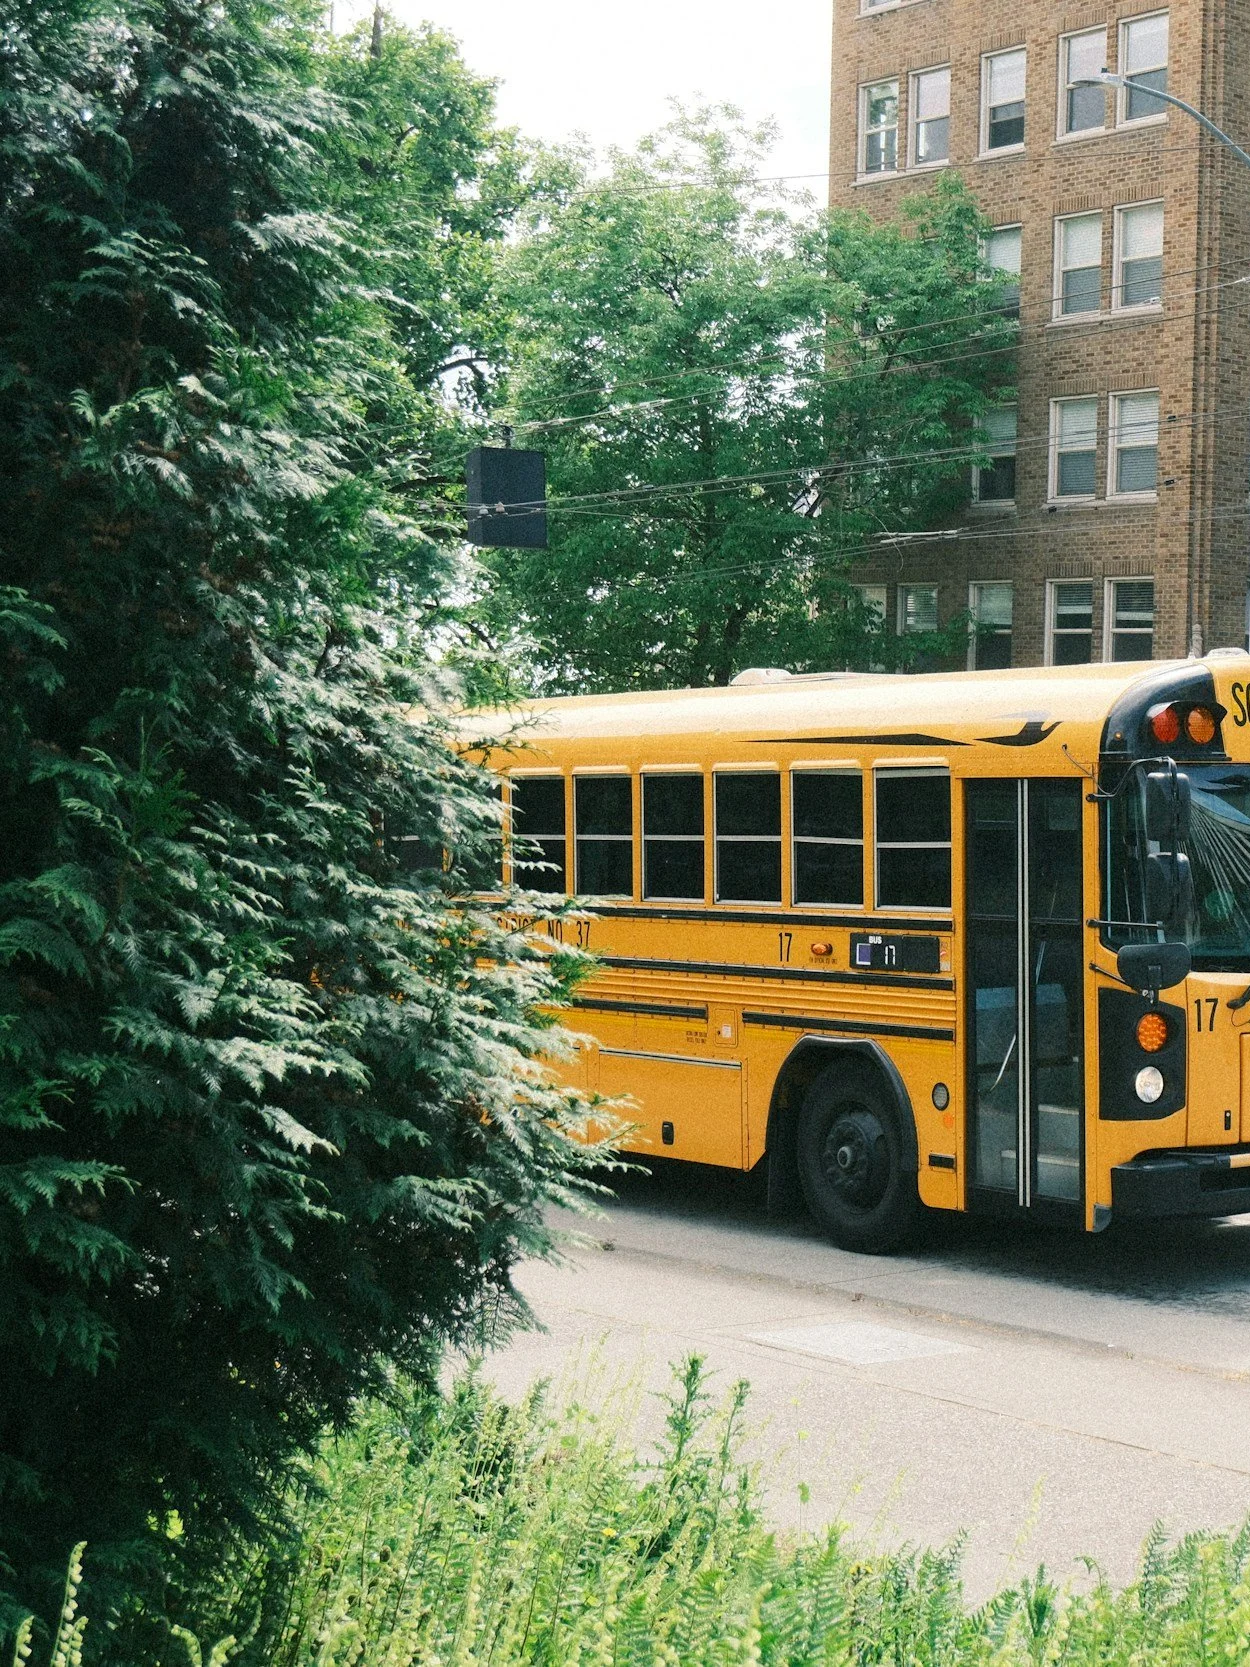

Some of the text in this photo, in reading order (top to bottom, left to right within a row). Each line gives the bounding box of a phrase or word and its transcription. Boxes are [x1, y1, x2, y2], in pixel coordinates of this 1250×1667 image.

[576, 920, 591, 948] 37
[778, 932, 793, 963] 17
[868, 936, 883, 945] BUS
[884, 945, 896, 966] 17
[1194, 998, 1218, 1032] 17
